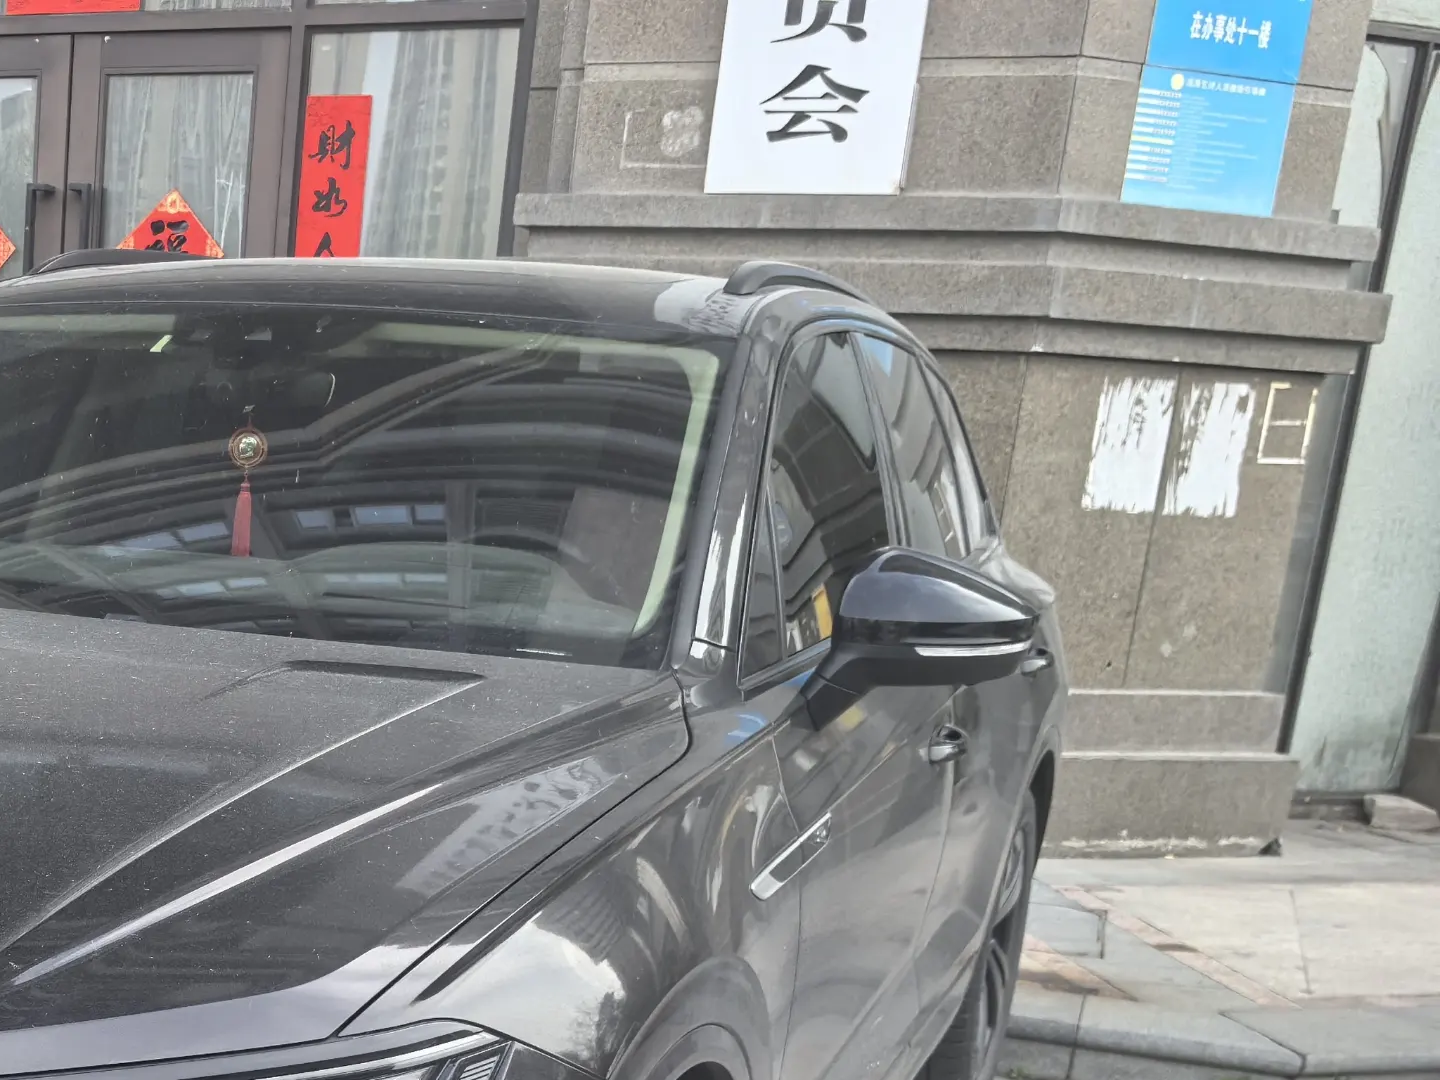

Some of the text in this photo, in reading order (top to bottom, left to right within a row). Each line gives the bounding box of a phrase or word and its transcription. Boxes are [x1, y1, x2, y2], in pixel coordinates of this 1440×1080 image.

[1190, 11, 1272, 49] 在办事处十一楼
